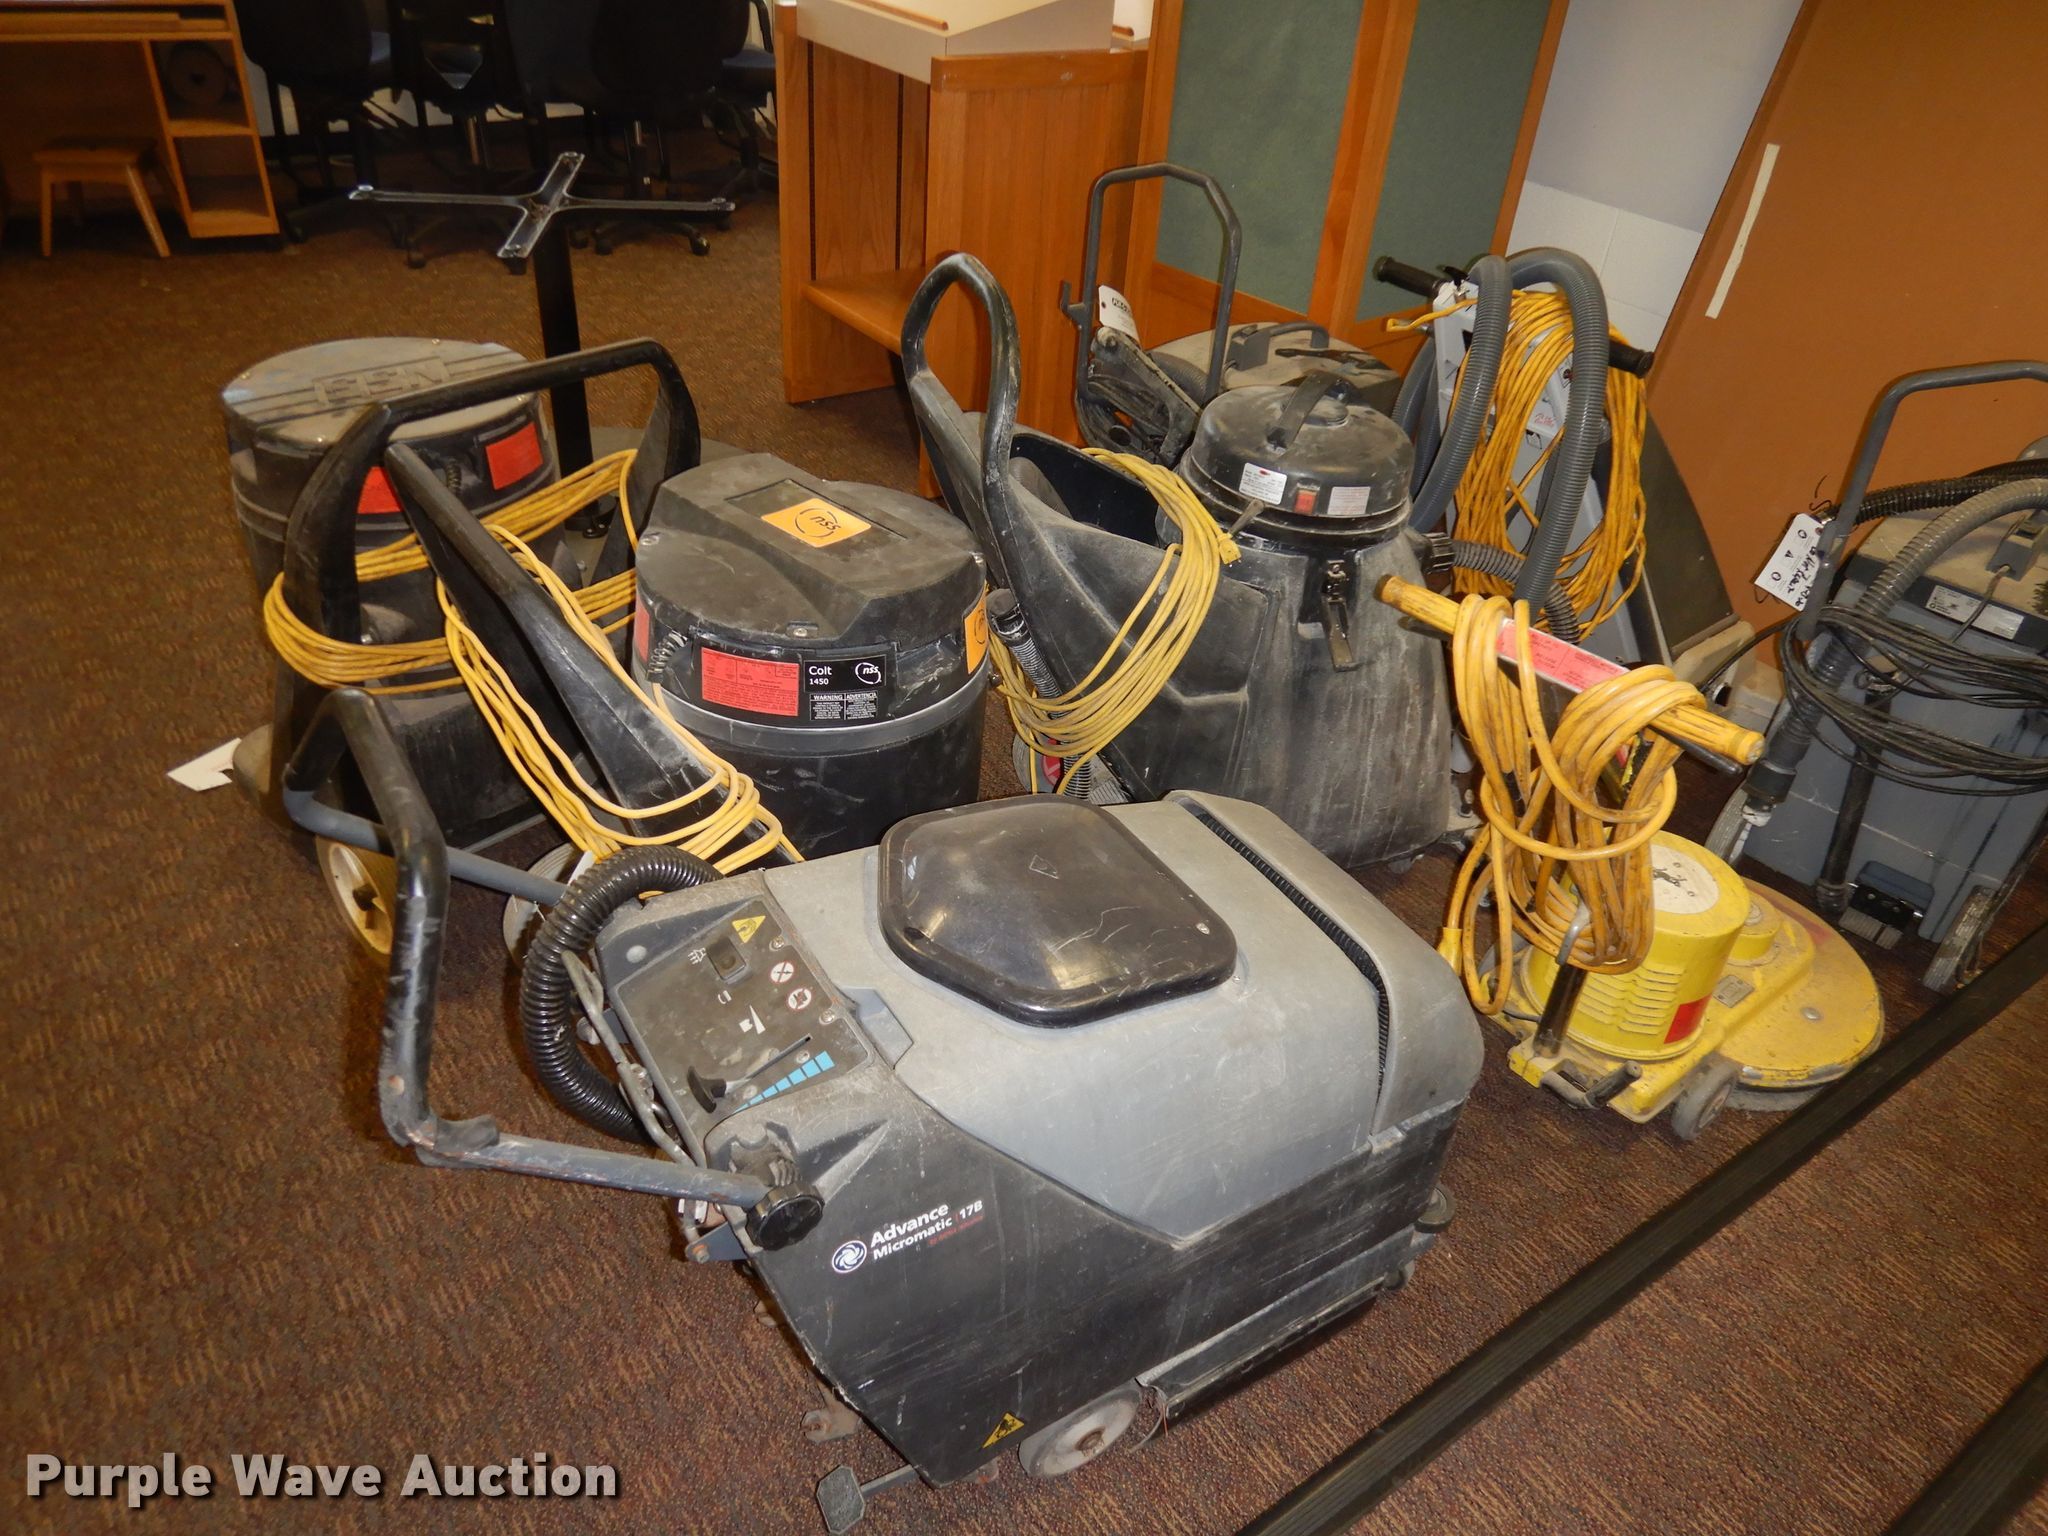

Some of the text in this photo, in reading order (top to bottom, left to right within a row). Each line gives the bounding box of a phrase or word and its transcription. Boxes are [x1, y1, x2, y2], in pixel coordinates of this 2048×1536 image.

[810, 515, 842, 530] nss
[808, 665, 833, 676] Colt
[862, 665, 880, 675] nss
[870, 1203, 950, 1248] Advance
[872, 1216, 954, 1260] Micromatic
[959, 1200, 984, 1220] 17B
